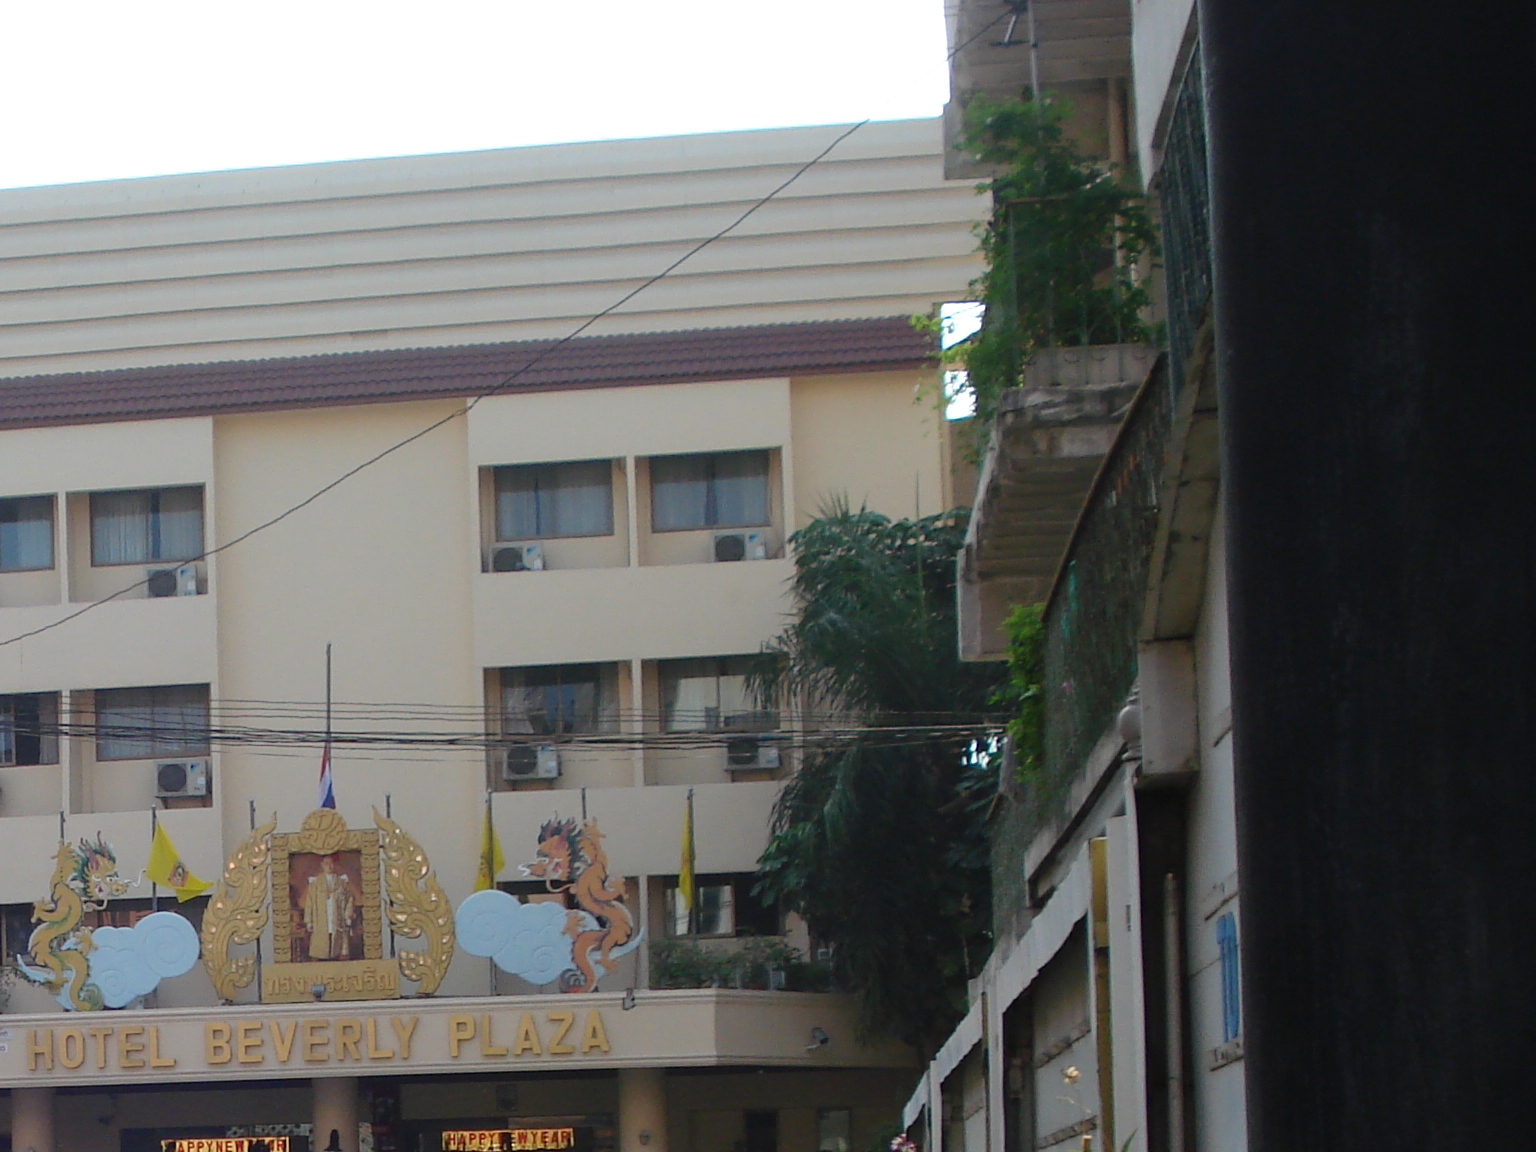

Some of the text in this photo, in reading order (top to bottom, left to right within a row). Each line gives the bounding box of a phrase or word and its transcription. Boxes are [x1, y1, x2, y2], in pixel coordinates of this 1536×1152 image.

[26, 1009, 611, 1070] HOTEL BEVERLY PLAZA
